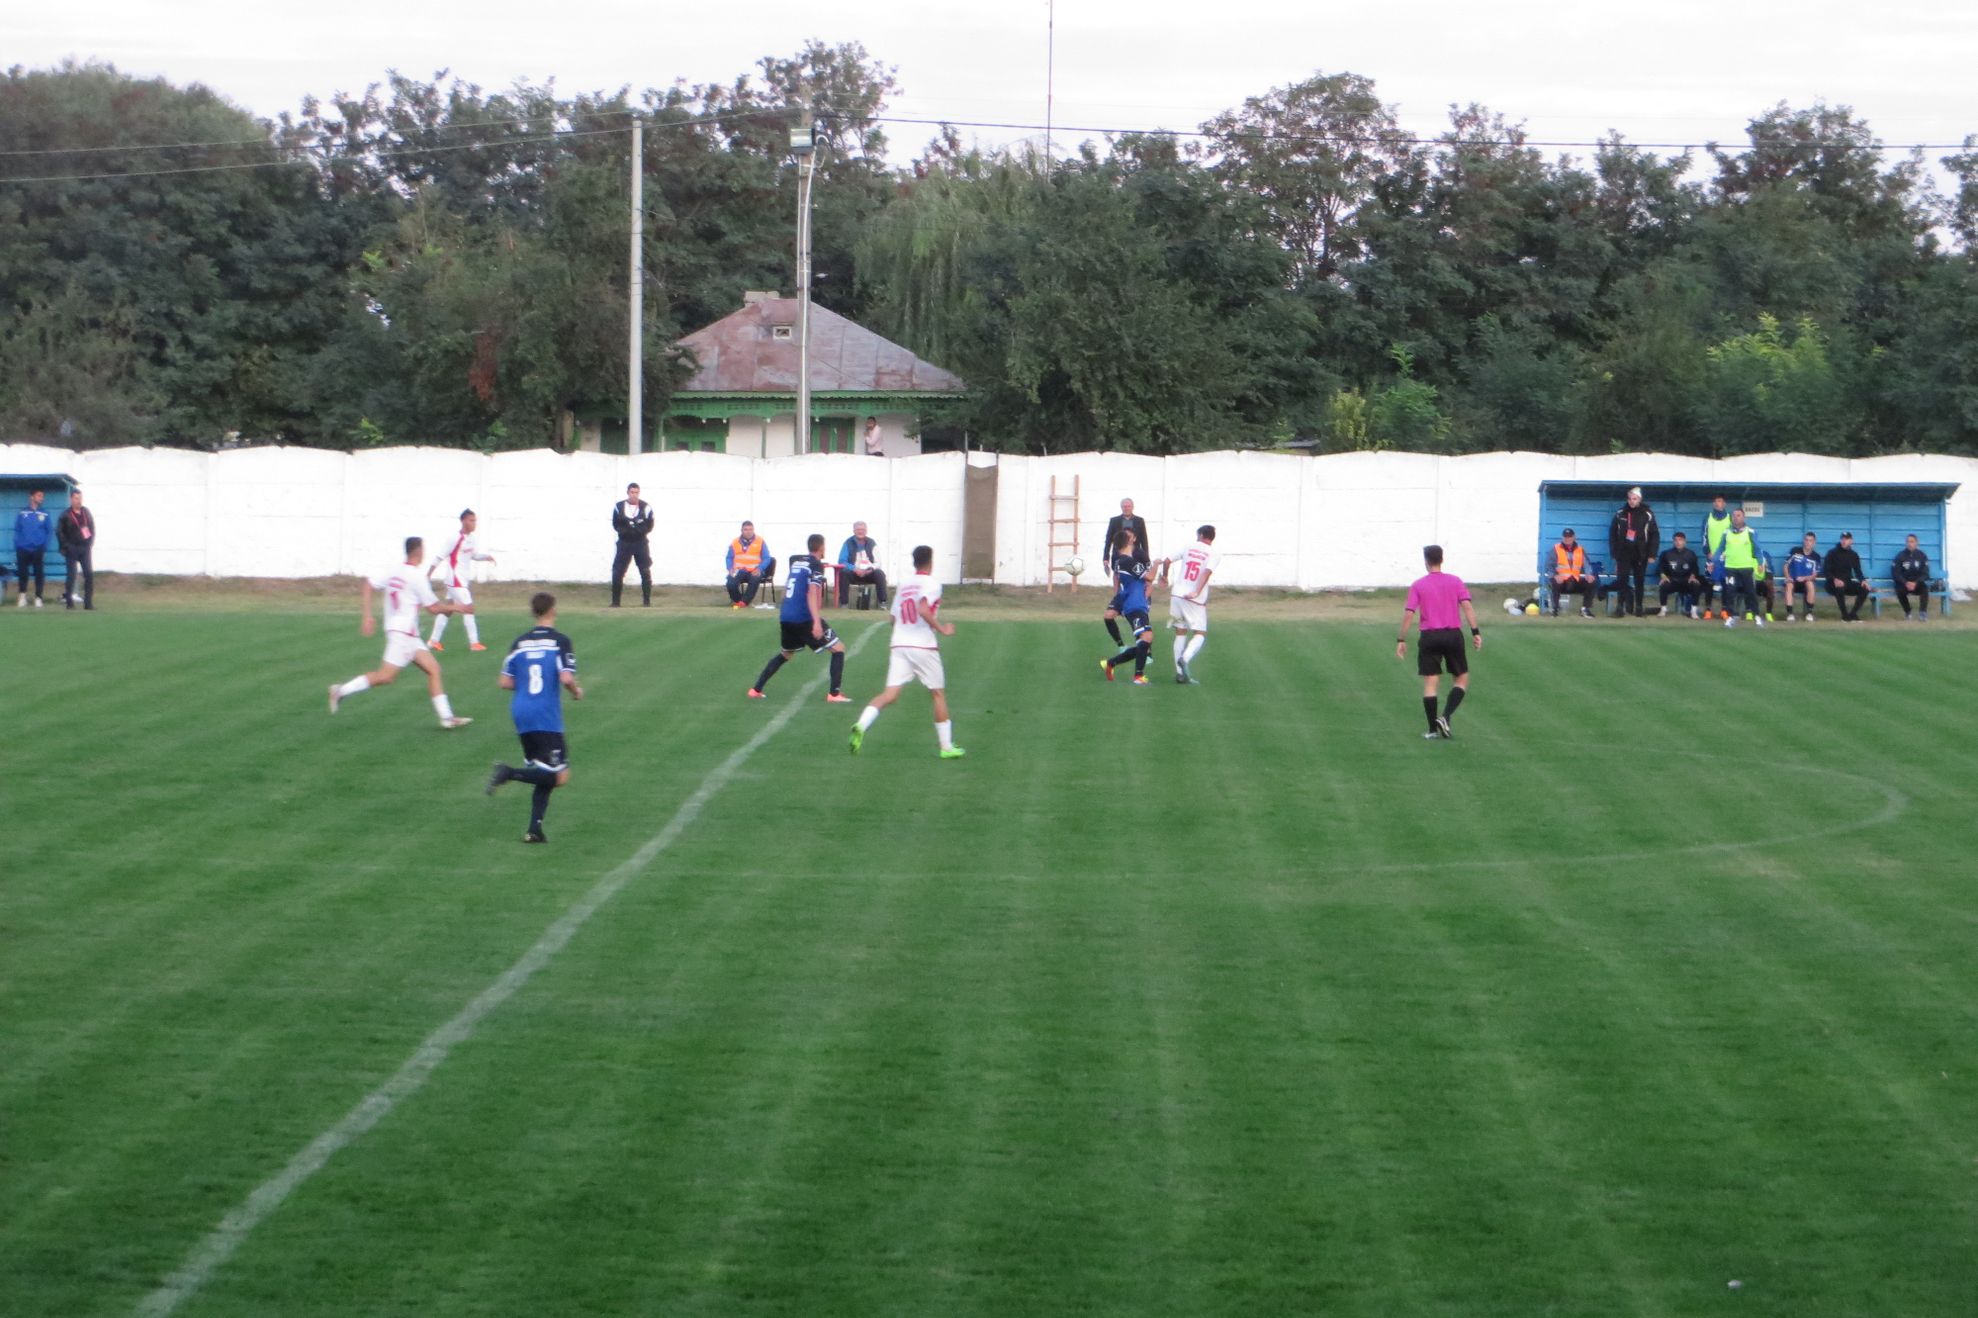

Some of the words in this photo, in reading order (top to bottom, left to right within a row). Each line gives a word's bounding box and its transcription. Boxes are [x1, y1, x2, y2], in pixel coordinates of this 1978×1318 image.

[1184, 561, 1200, 582] 15
[1725, 576, 1734, 585] 14
[785, 577, 796, 598] 5
[901, 598, 917, 625] 10
[528, 664, 543, 695] 8
